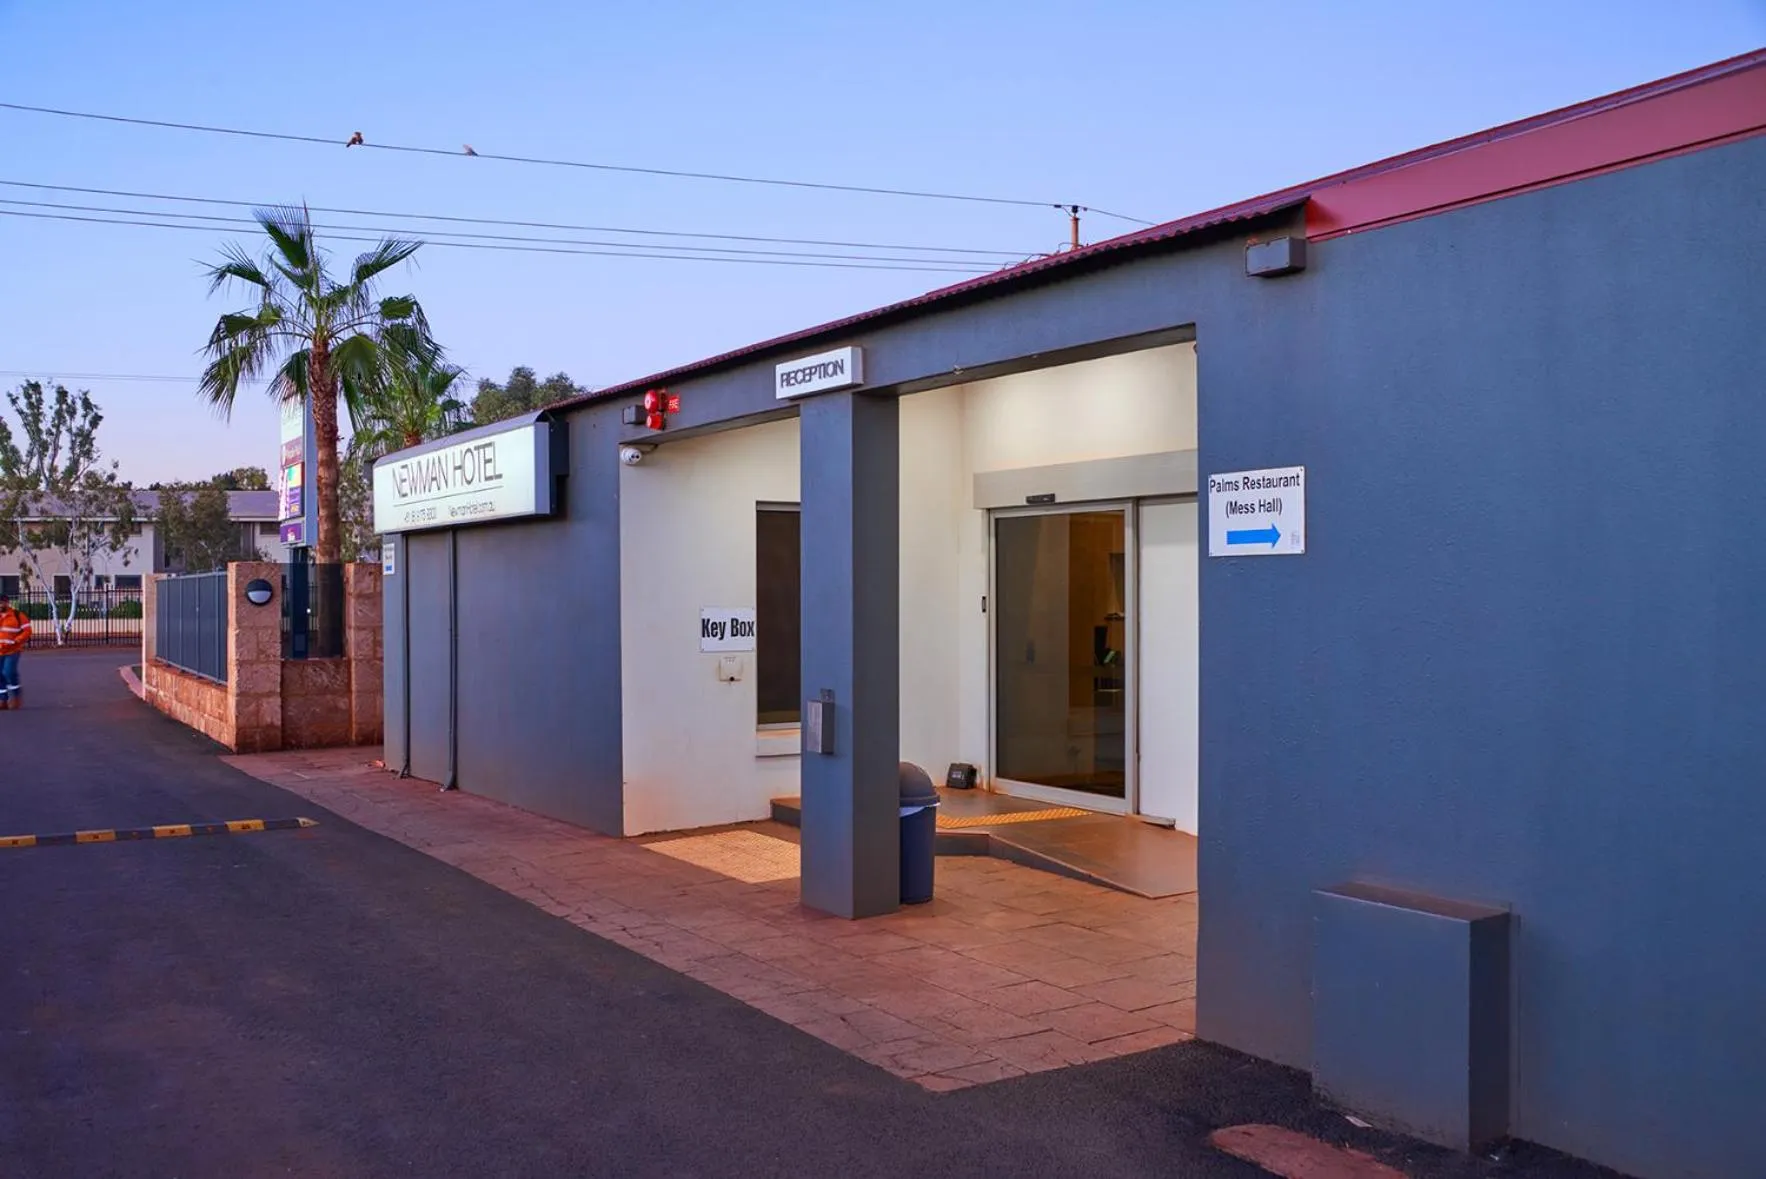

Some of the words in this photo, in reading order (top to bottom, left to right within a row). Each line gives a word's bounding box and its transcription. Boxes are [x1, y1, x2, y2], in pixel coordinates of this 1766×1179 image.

[780, 359, 844, 388] RECEPTION
[392, 453, 448, 500] NEWMAN
[452, 441, 503, 487] HOTEL
[1209, 479, 1240, 494] Palms
[1242, 473, 1301, 491] Restaurant
[1225, 500, 1256, 519] (Mess
[1258, 497, 1283, 516] Hall)
[701, 618, 727, 641] Key
[730, 617, 755, 638] Box
